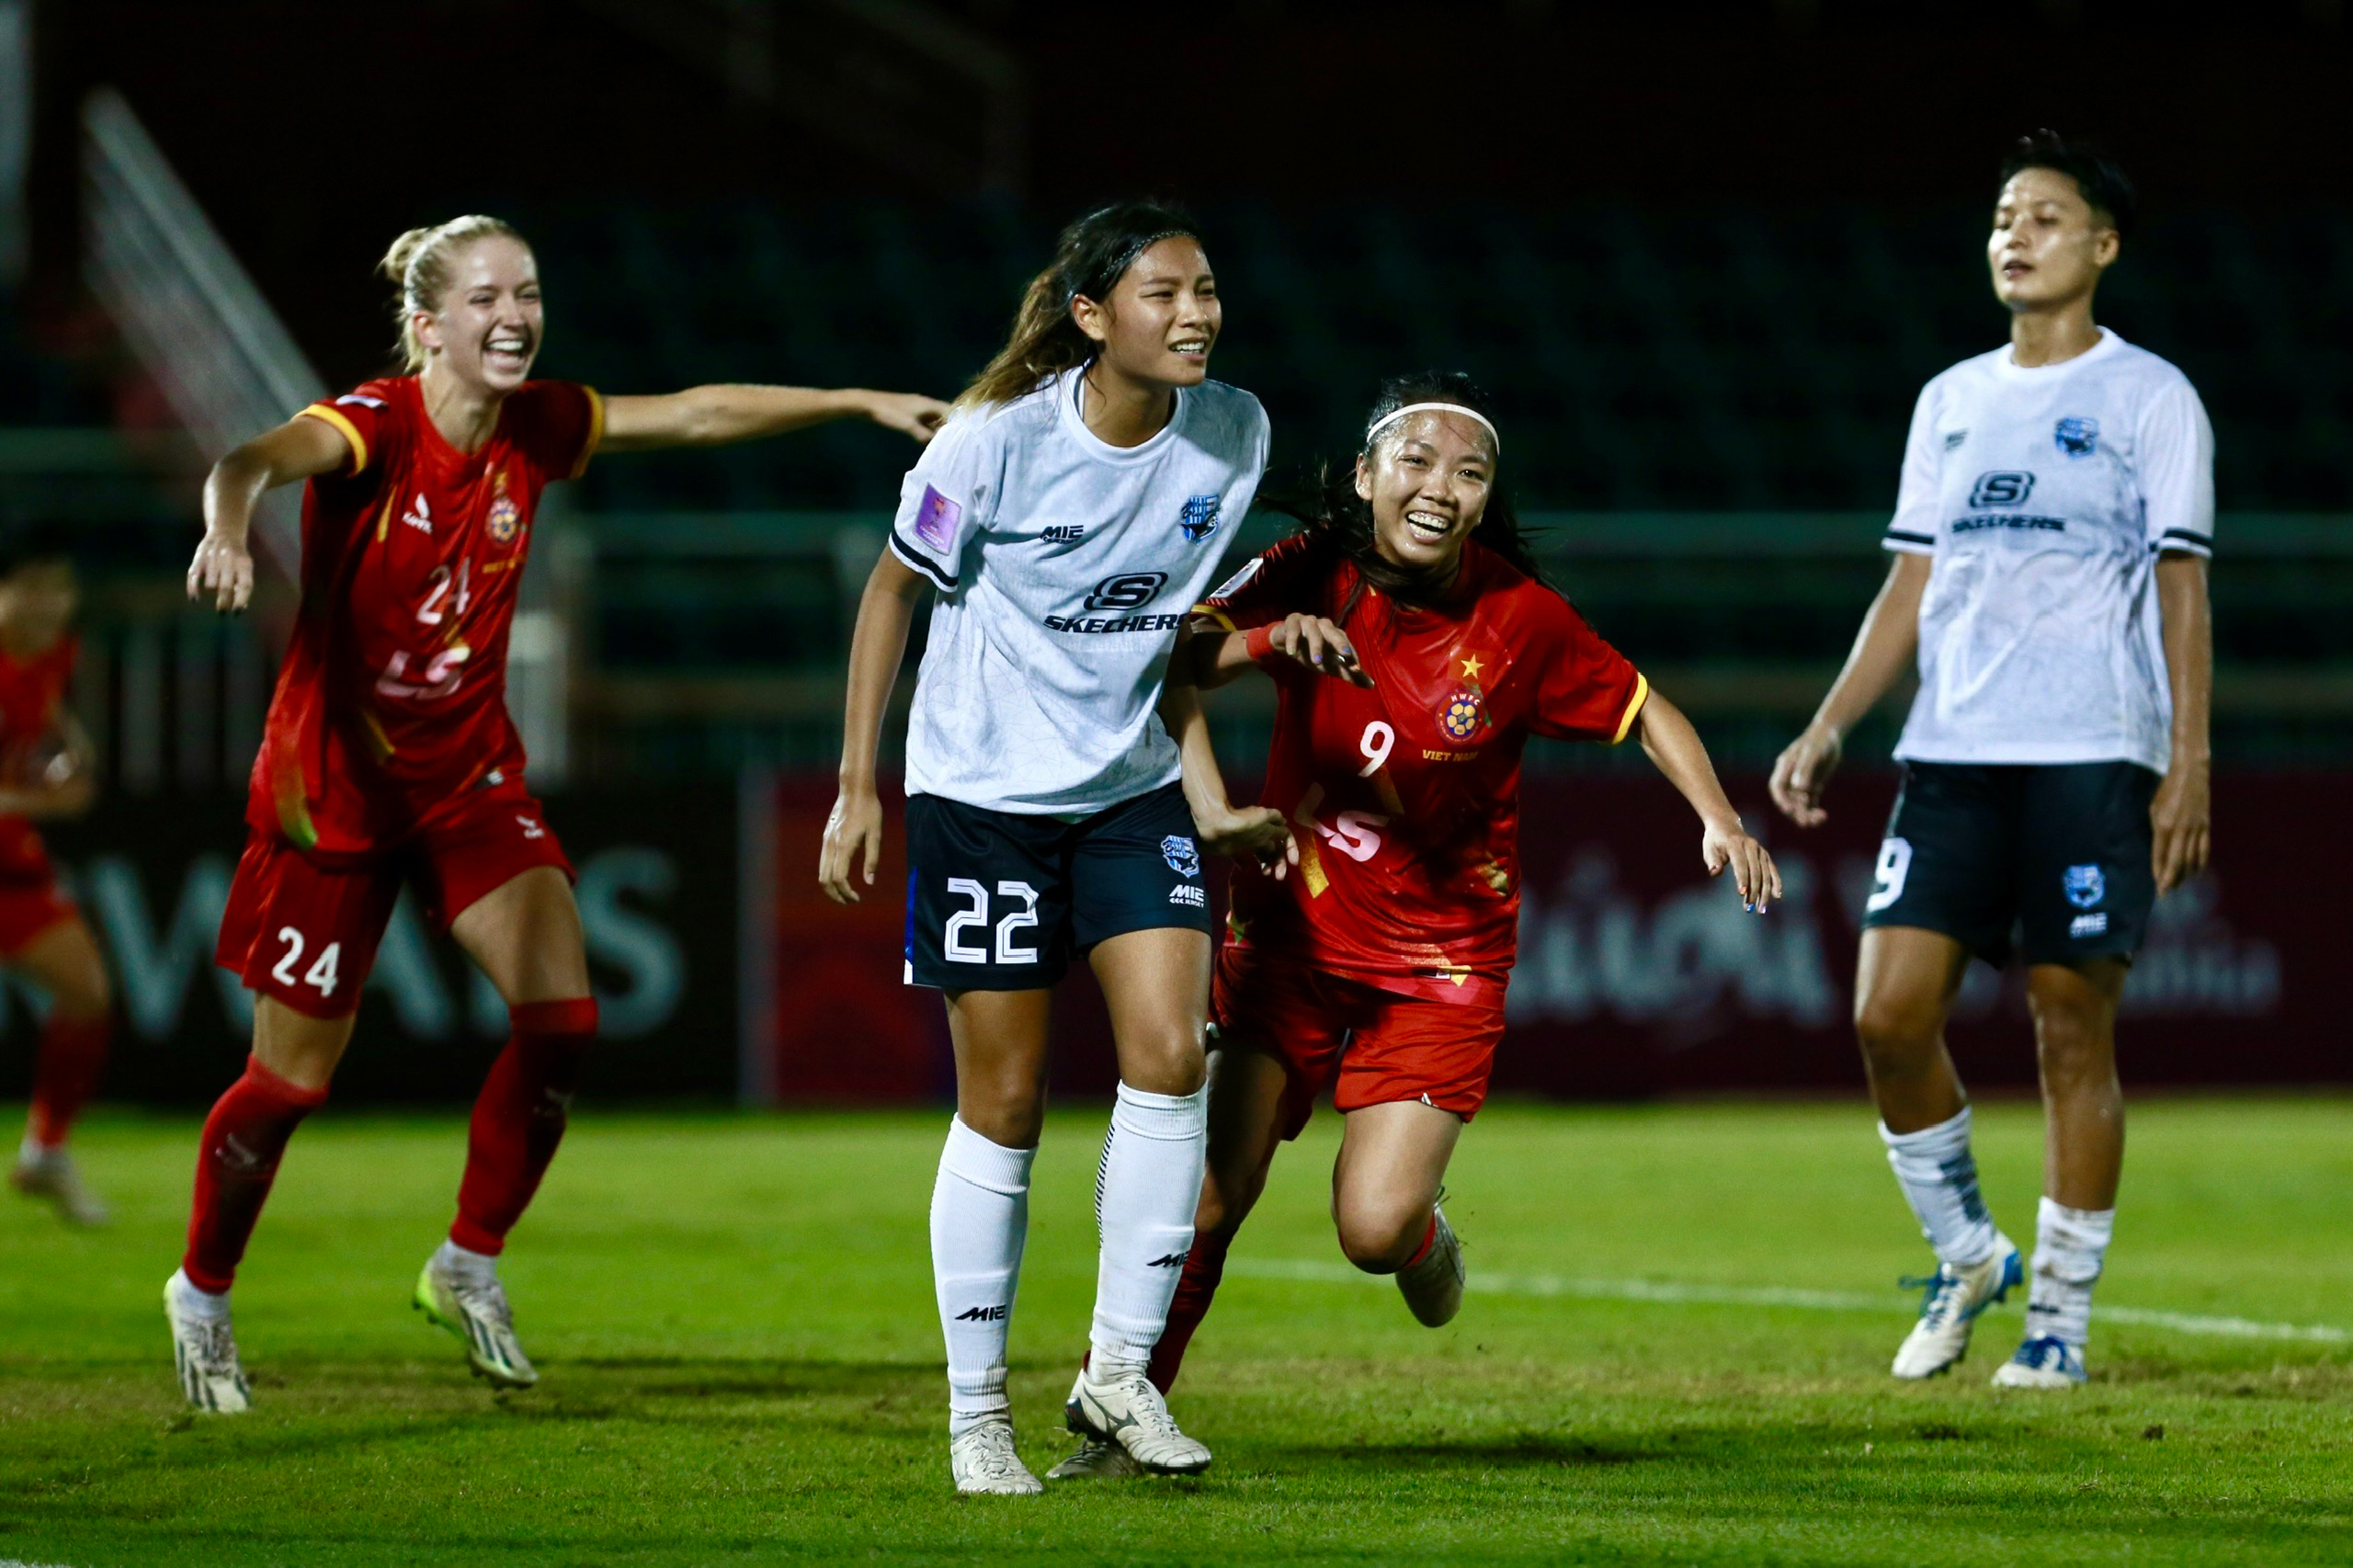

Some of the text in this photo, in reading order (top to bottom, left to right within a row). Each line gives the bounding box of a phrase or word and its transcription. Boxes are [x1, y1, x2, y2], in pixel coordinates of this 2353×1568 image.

[1040, 525, 1084, 540] MIE
[415, 555, 472, 626] 24
[375, 649, 472, 701] LS
[1358, 721, 1395, 778] 9
[1422, 749, 1452, 762] VIET
[1293, 780, 1390, 862] LS
[1169, 884, 1204, 903] MIE
[1866, 837, 1913, 903] 9
[945, 878, 1040, 964] 22
[271, 925, 341, 998] 24
[954, 1304, 1006, 1321] MIE
